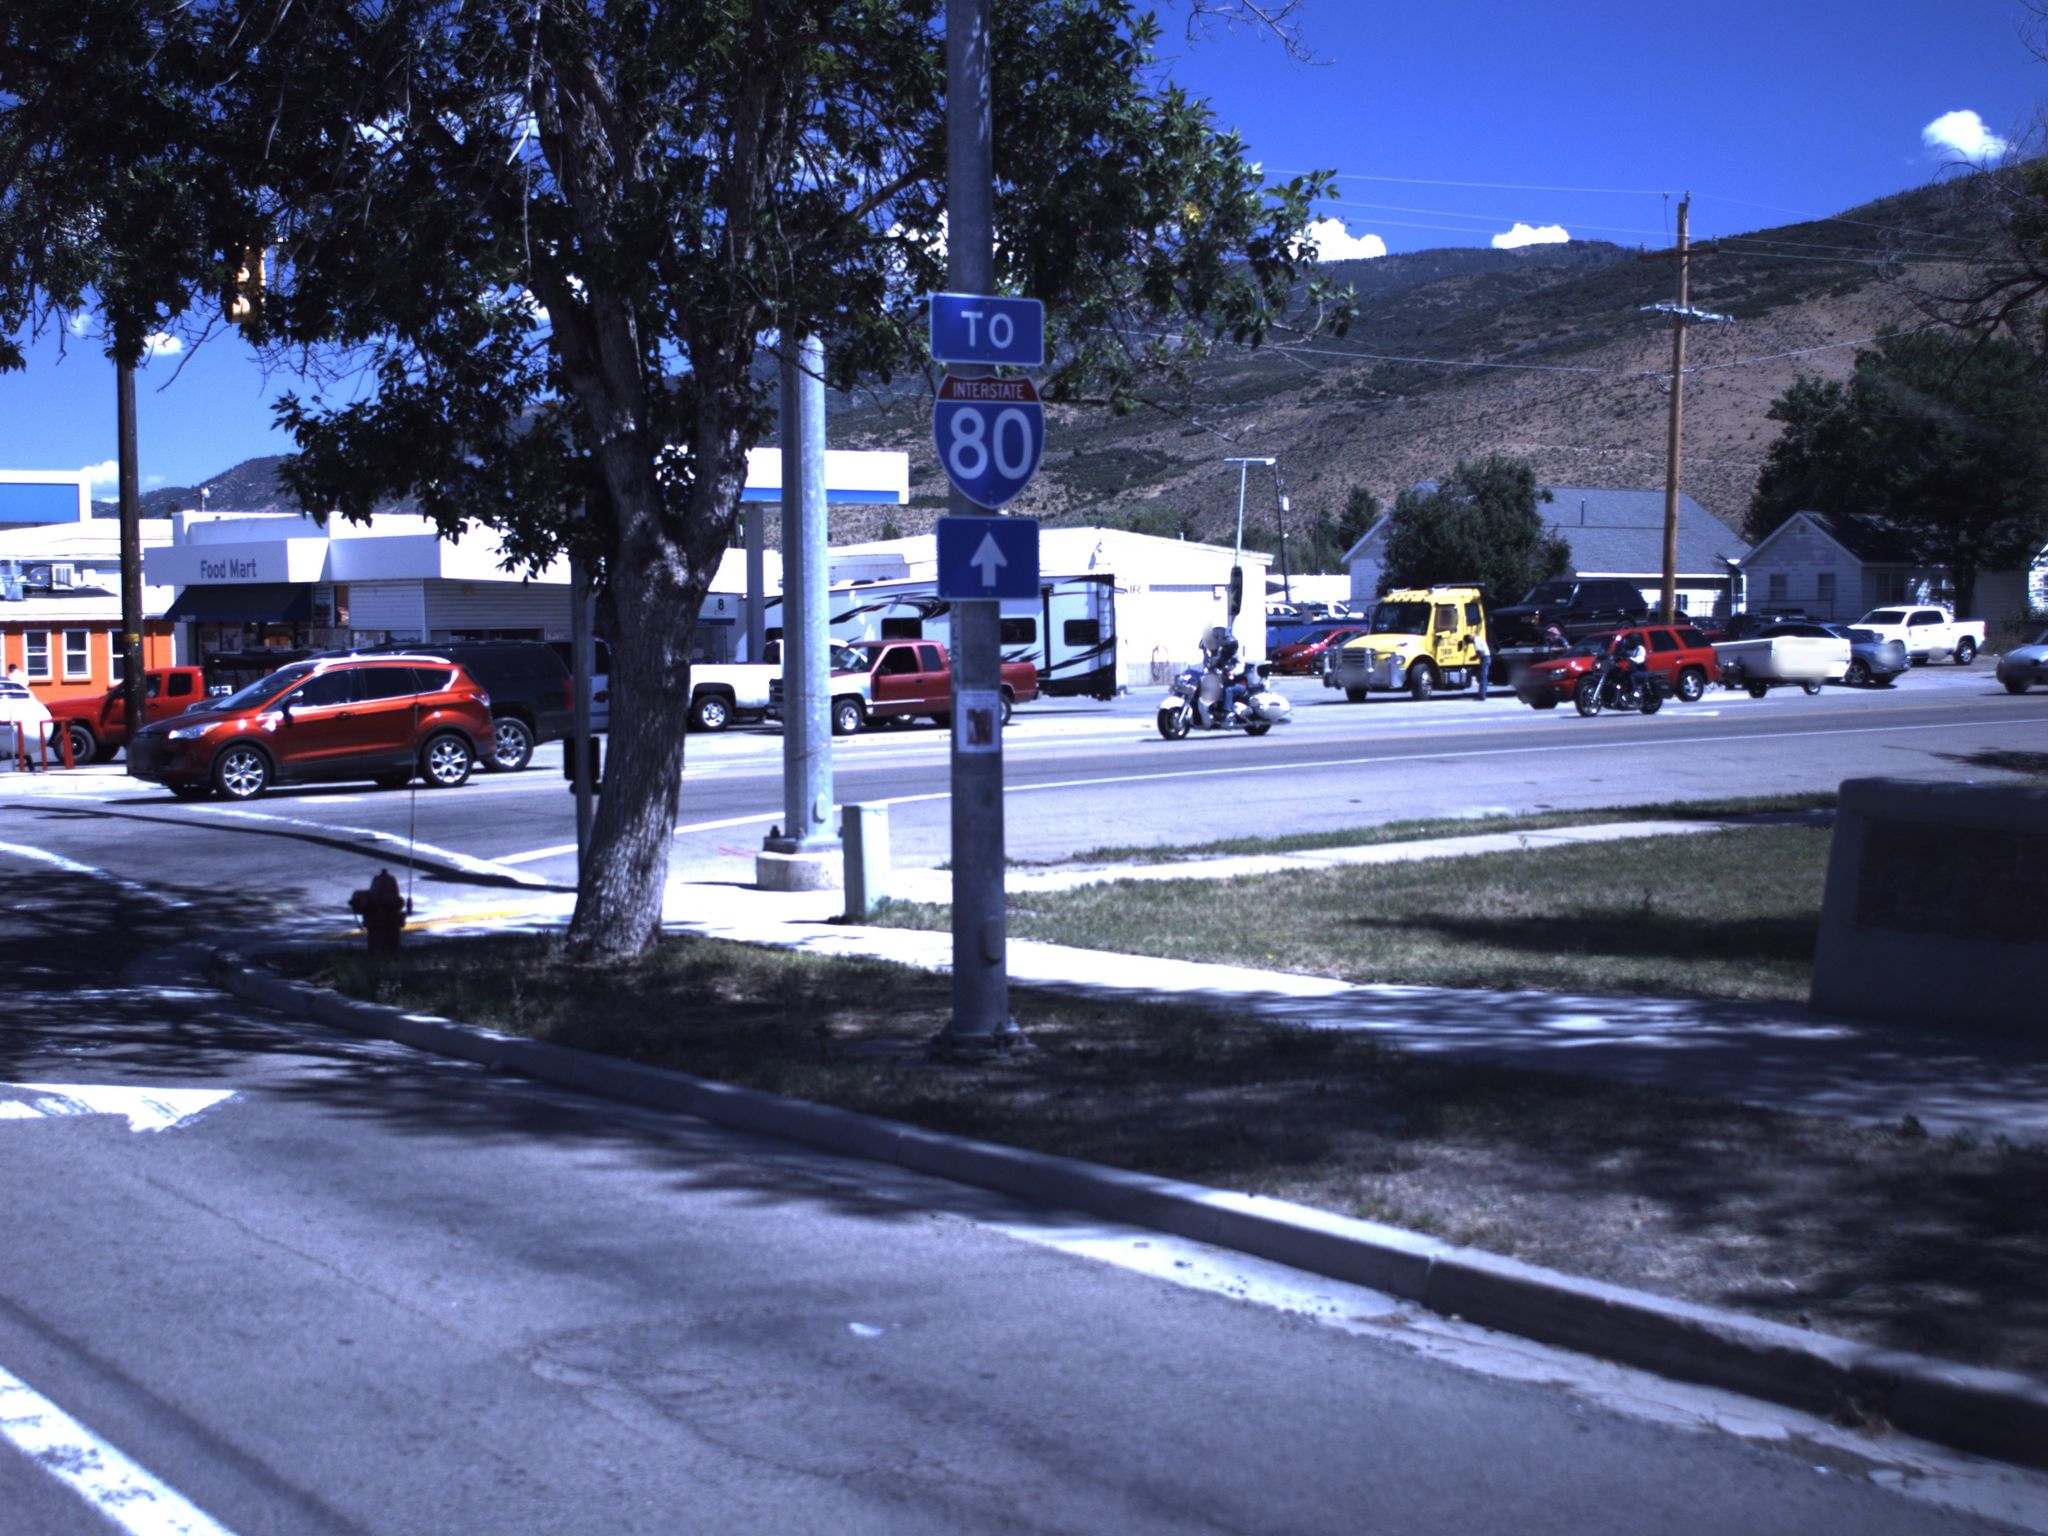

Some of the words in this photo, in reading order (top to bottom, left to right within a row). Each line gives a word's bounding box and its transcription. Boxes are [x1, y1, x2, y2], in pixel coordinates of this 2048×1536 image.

[960, 310, 1014, 349] TO
[952, 381, 1025, 400] INTERSTATE
[948, 406, 1034, 480] 80
[200, 559, 226, 579] Food
[229, 557, 257, 579] Mart
[717, 598, 725, 611] 8
